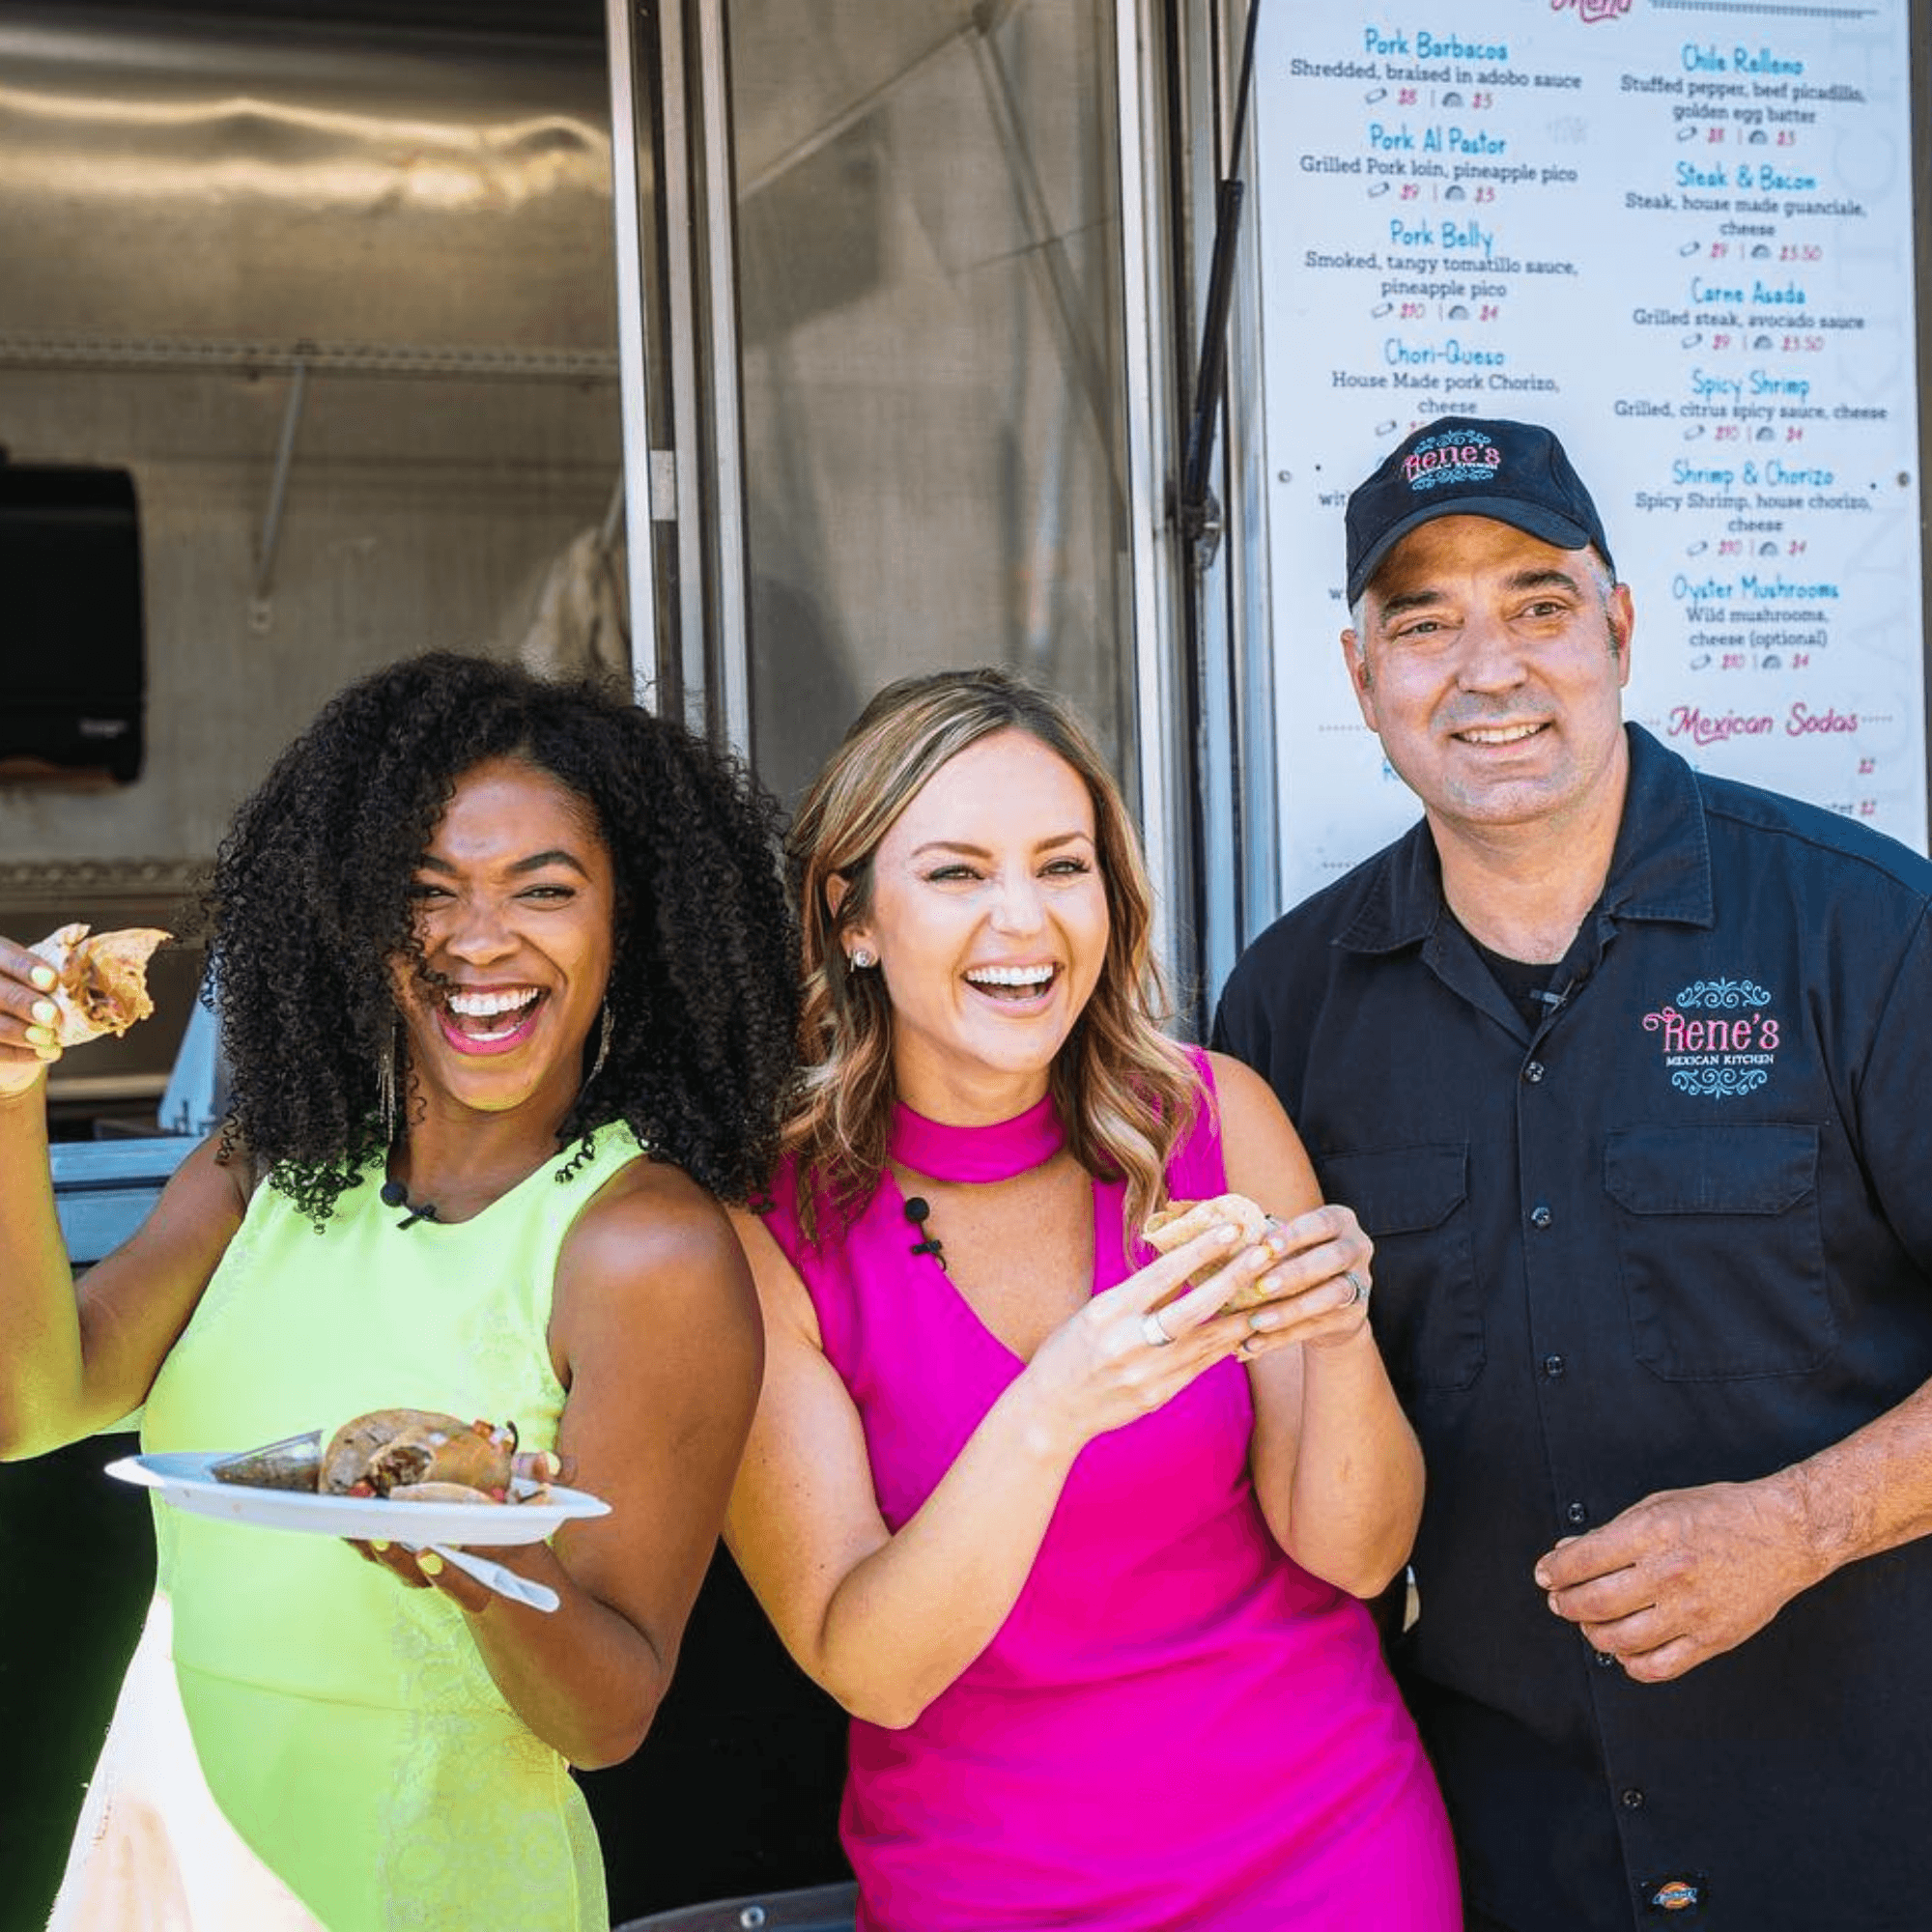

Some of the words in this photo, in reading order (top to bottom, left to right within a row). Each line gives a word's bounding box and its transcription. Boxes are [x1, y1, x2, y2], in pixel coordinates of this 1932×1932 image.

[1364, 27, 1406, 54] Pork
[1416, 31, 1508, 61] Barbacoa
[1683, 44, 1725, 72] Chile
[1734, 46, 1803, 74] Relleno
[1292, 58, 1380, 81] Shredded,
[1386, 64, 1449, 83] braised
[1457, 67, 1472, 83] in
[1477, 71, 1529, 86] adobo
[1534, 74, 1581, 88] sauce
[1621, 74, 1683, 94] Stuffed
[1688, 77, 1748, 98] pepper,
[1753, 81, 1787, 98] beef
[1673, 103, 1728, 121] golden
[1734, 108, 1763, 124] egg
[1370, 124, 1413, 150] Pork
[1424, 128, 1442, 152] Al
[1449, 128, 1506, 155] Pastor
[1300, 155, 1361, 174] Grilled
[1367, 159, 1406, 175] Pork
[1410, 160, 1448, 178] loin,
[1454, 165, 1536, 183] pineapple
[1542, 167, 1577, 185] pico
[1677, 160, 1727, 187] Steak
[1738, 164, 1752, 188] &
[1759, 164, 1816, 190] Bacon
[1626, 193, 1677, 211] Steak,
[1682, 193, 1729, 212] house
[1735, 195, 1778, 213] made
[1784, 200, 1867, 217] guanciale,
[1390, 218, 1433, 244] Pork
[1442, 221, 1493, 257] Belly
[1720, 220, 1776, 237] cheese
[1305, 251, 1382, 270] Smoked,
[1387, 256, 1437, 274] tangy
[1443, 257, 1520, 273] tomatillo
[1525, 261, 1579, 276] sauce,
[1381, 281, 1465, 298] pineapple
[1471, 283, 1506, 299] pico
[1692, 277, 1744, 304] Carne
[1752, 281, 1805, 304] Asada
[1479, 304, 1499, 322] $4
[1634, 309, 1689, 326] Grilled
[1694, 312, 1743, 327] steak,
[1748, 313, 1815, 328] avocado
[1819, 317, 1864, 329] sauce
[1385, 338, 1504, 365] Chori-Queso
[1332, 371, 1387, 387] House
[1392, 373, 1440, 389] Made
[1444, 374, 1484, 392] pork
[1489, 374, 1559, 393] Chorizo,
[1692, 369, 1742, 403] Spicy
[1750, 370, 1809, 404] Shrimp
[1417, 397, 1477, 413] cheese
[1614, 400, 1674, 418] Grilled,
[1679, 403, 1727, 419] citrus
[1732, 405, 1776, 422] spicy
[1779, 407, 1829, 421] sauce,
[1833, 407, 1888, 420] cheese
[1672, 460, 1734, 490] Shrimp
[1744, 460, 1757, 485] &
[1766, 460, 1833, 487] Chorizo
[1635, 492, 1682, 511] Spicy
[1688, 493, 1749, 512] Shrimp,
[1756, 494, 1804, 509] house
[1808, 496, 1873, 512] chorizo,
[1727, 519, 1784, 532] cheese
[1673, 574, 1732, 606] Oyster
[1742, 576, 1838, 599] Mushrooms
[1687, 607, 1725, 623] Wild
[1729, 609, 1830, 624] mushrooms,
[1690, 631, 1744, 647] cheese
[1749, 633, 1827, 648] (optional)
[1667, 706, 1773, 746] Mexican
[1787, 702, 1858, 736] Sodas
[1642, 1007, 1779, 1052] Rene's
[1666, 1055, 1719, 1066] MEXICAN
[1724, 1055, 1774, 1065] KITCHEN
